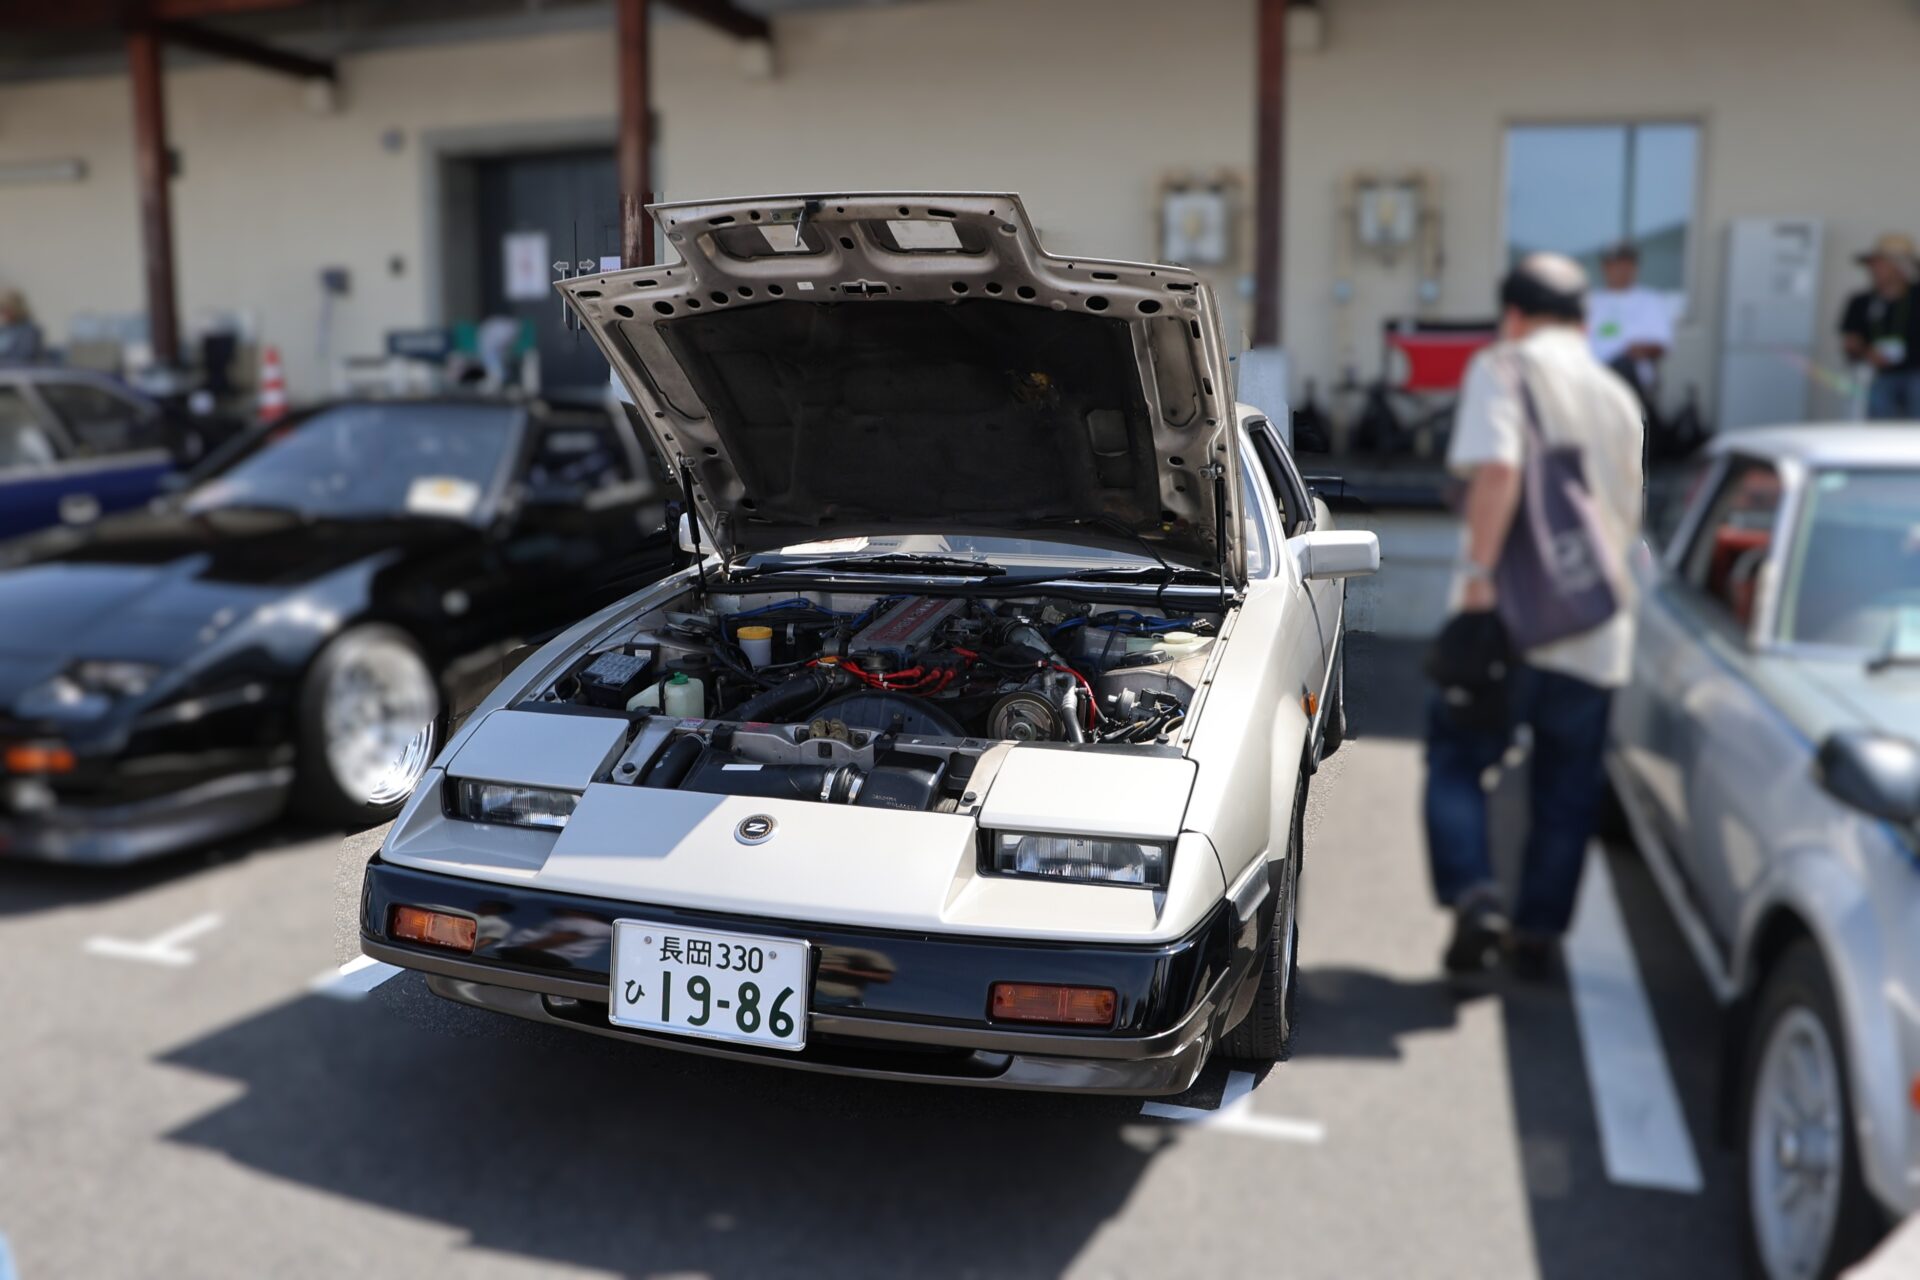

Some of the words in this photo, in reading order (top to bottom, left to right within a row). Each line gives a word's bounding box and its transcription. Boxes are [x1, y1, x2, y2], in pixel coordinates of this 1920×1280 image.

[746, 822, 767, 833] Z
[659, 936, 764, 974] 長岡330
[624, 979, 646, 1005] ひ
[661, 970, 795, 1038] 19-86
